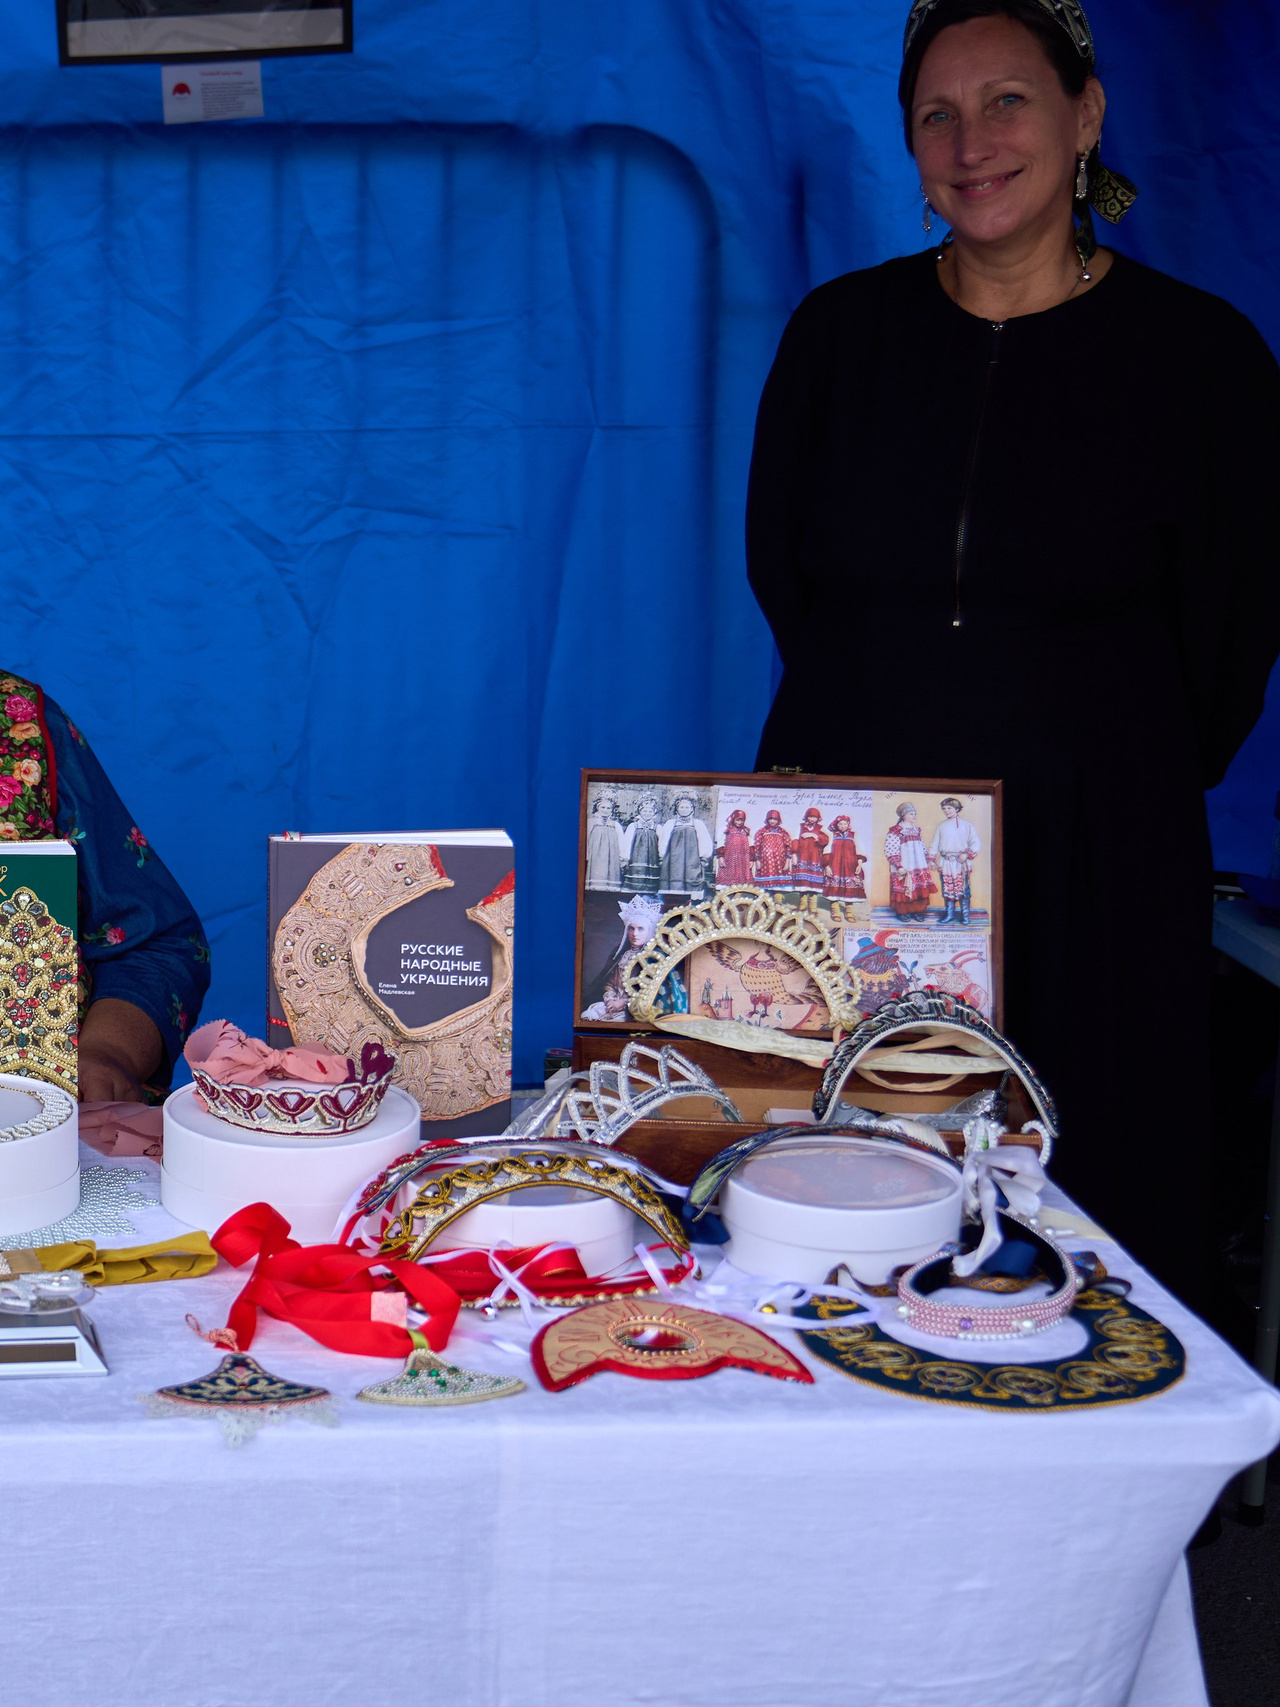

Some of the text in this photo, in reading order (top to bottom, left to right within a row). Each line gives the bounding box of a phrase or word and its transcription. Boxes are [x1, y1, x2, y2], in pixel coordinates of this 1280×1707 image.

[400, 943, 464, 956] РУССКИЕ
[400, 958, 482, 972] НАРОДНЫЕ
[400, 973, 488, 987] УКРАШЕНИЯ
